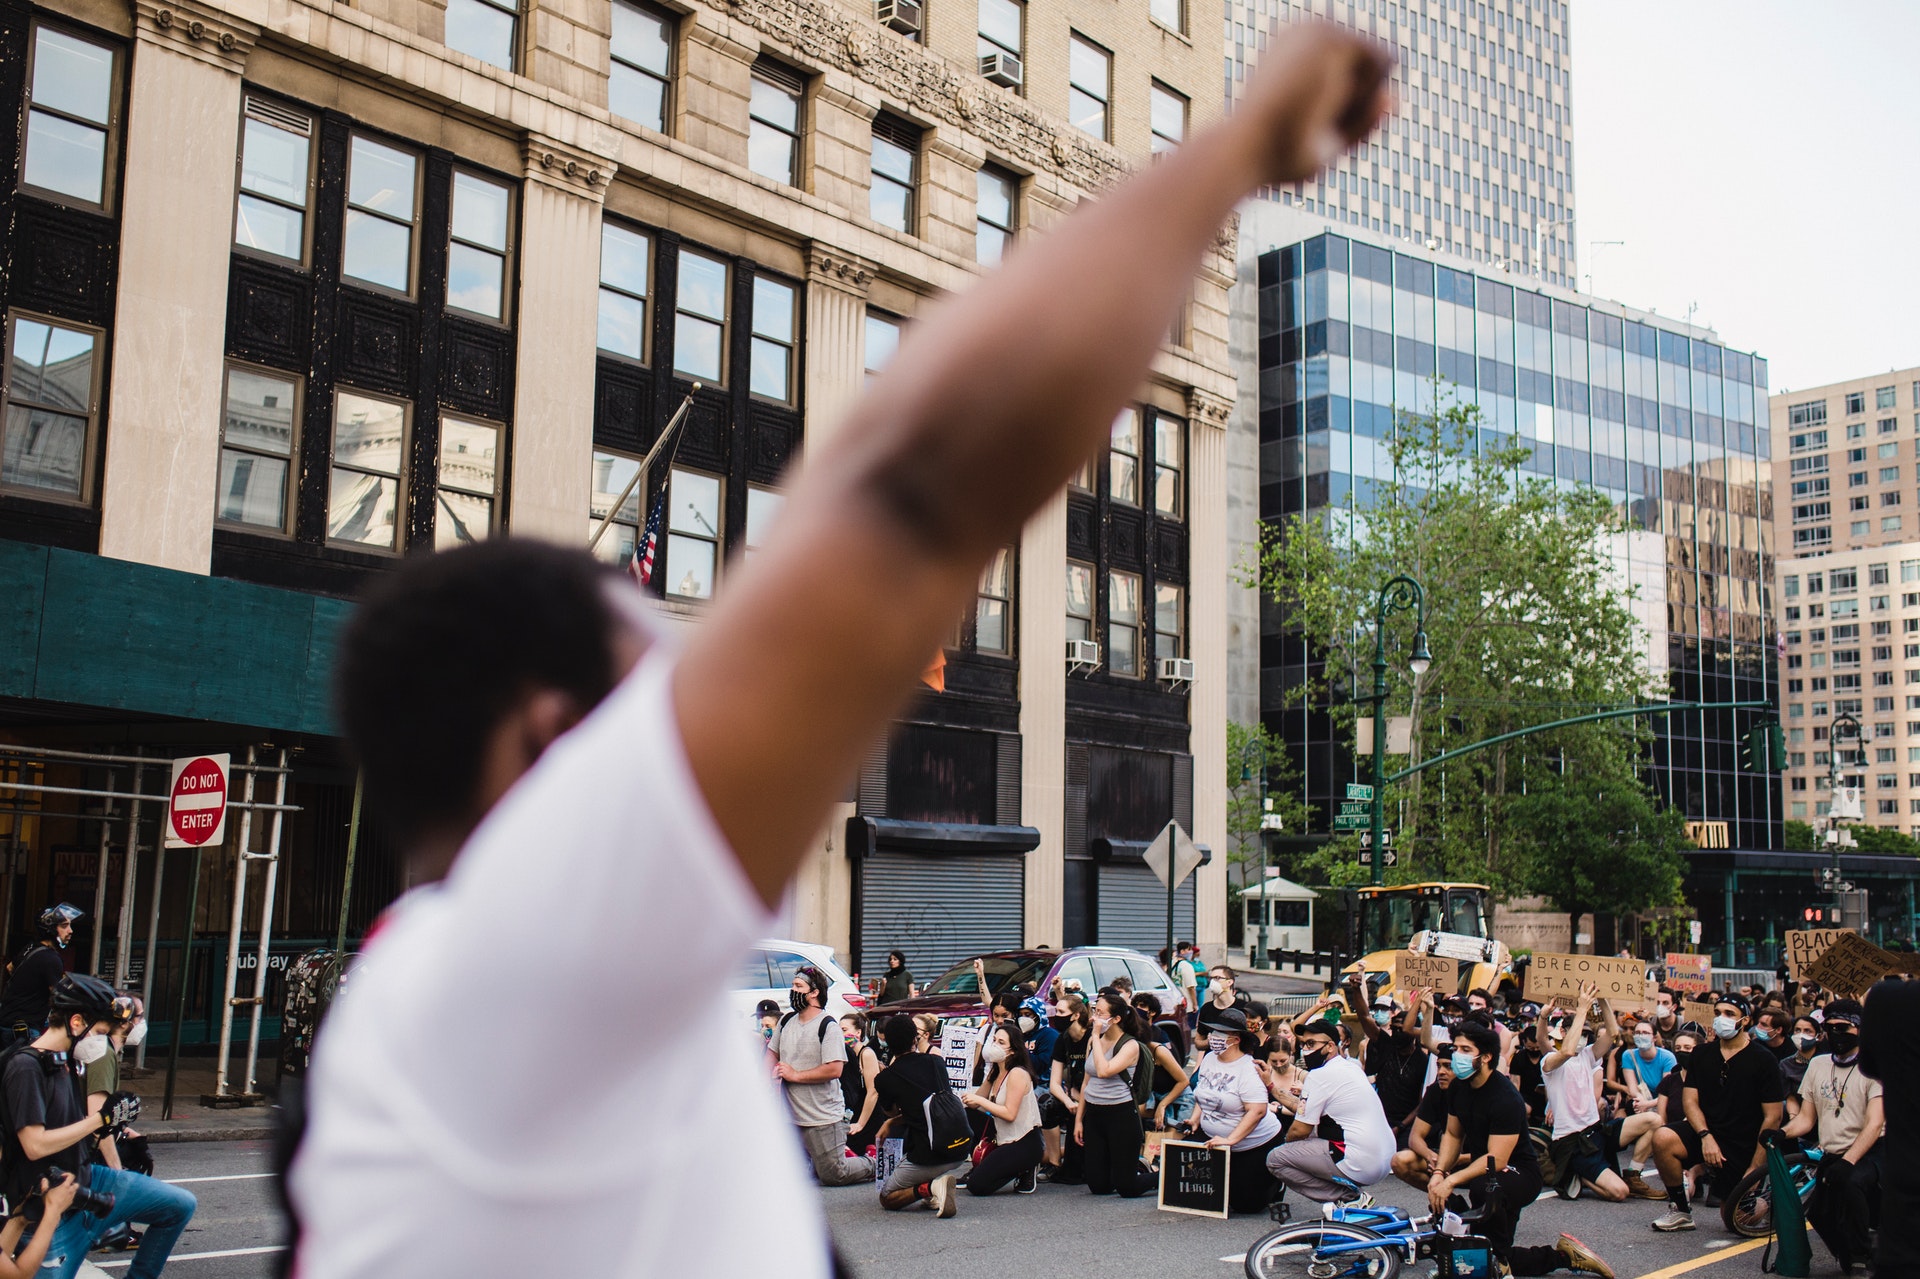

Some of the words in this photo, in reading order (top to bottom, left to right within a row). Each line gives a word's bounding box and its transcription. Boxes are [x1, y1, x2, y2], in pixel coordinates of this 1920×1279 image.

[182, 776, 197, 790] DO
[200, 773, 219, 788] NOT
[1341, 804, 1363, 815] DUANE
[181, 813, 213, 829] ENTER
[1841, 933, 1876, 960] THERE
[225, 953, 289, 971] ubay
[1405, 958, 1450, 973] DEFUND
[1537, 956, 1640, 975] BREONNA
[1667, 953, 1698, 966] Black
[1416, 969, 1430, 977] THE
[1667, 966, 1705, 980] Trauma
[1822, 954, 1871, 987] SILENCE
[1403, 975, 1443, 988] POLICE
[952, 1040, 965, 1048] BLACK
[946, 1058, 965, 1067] LIVES
